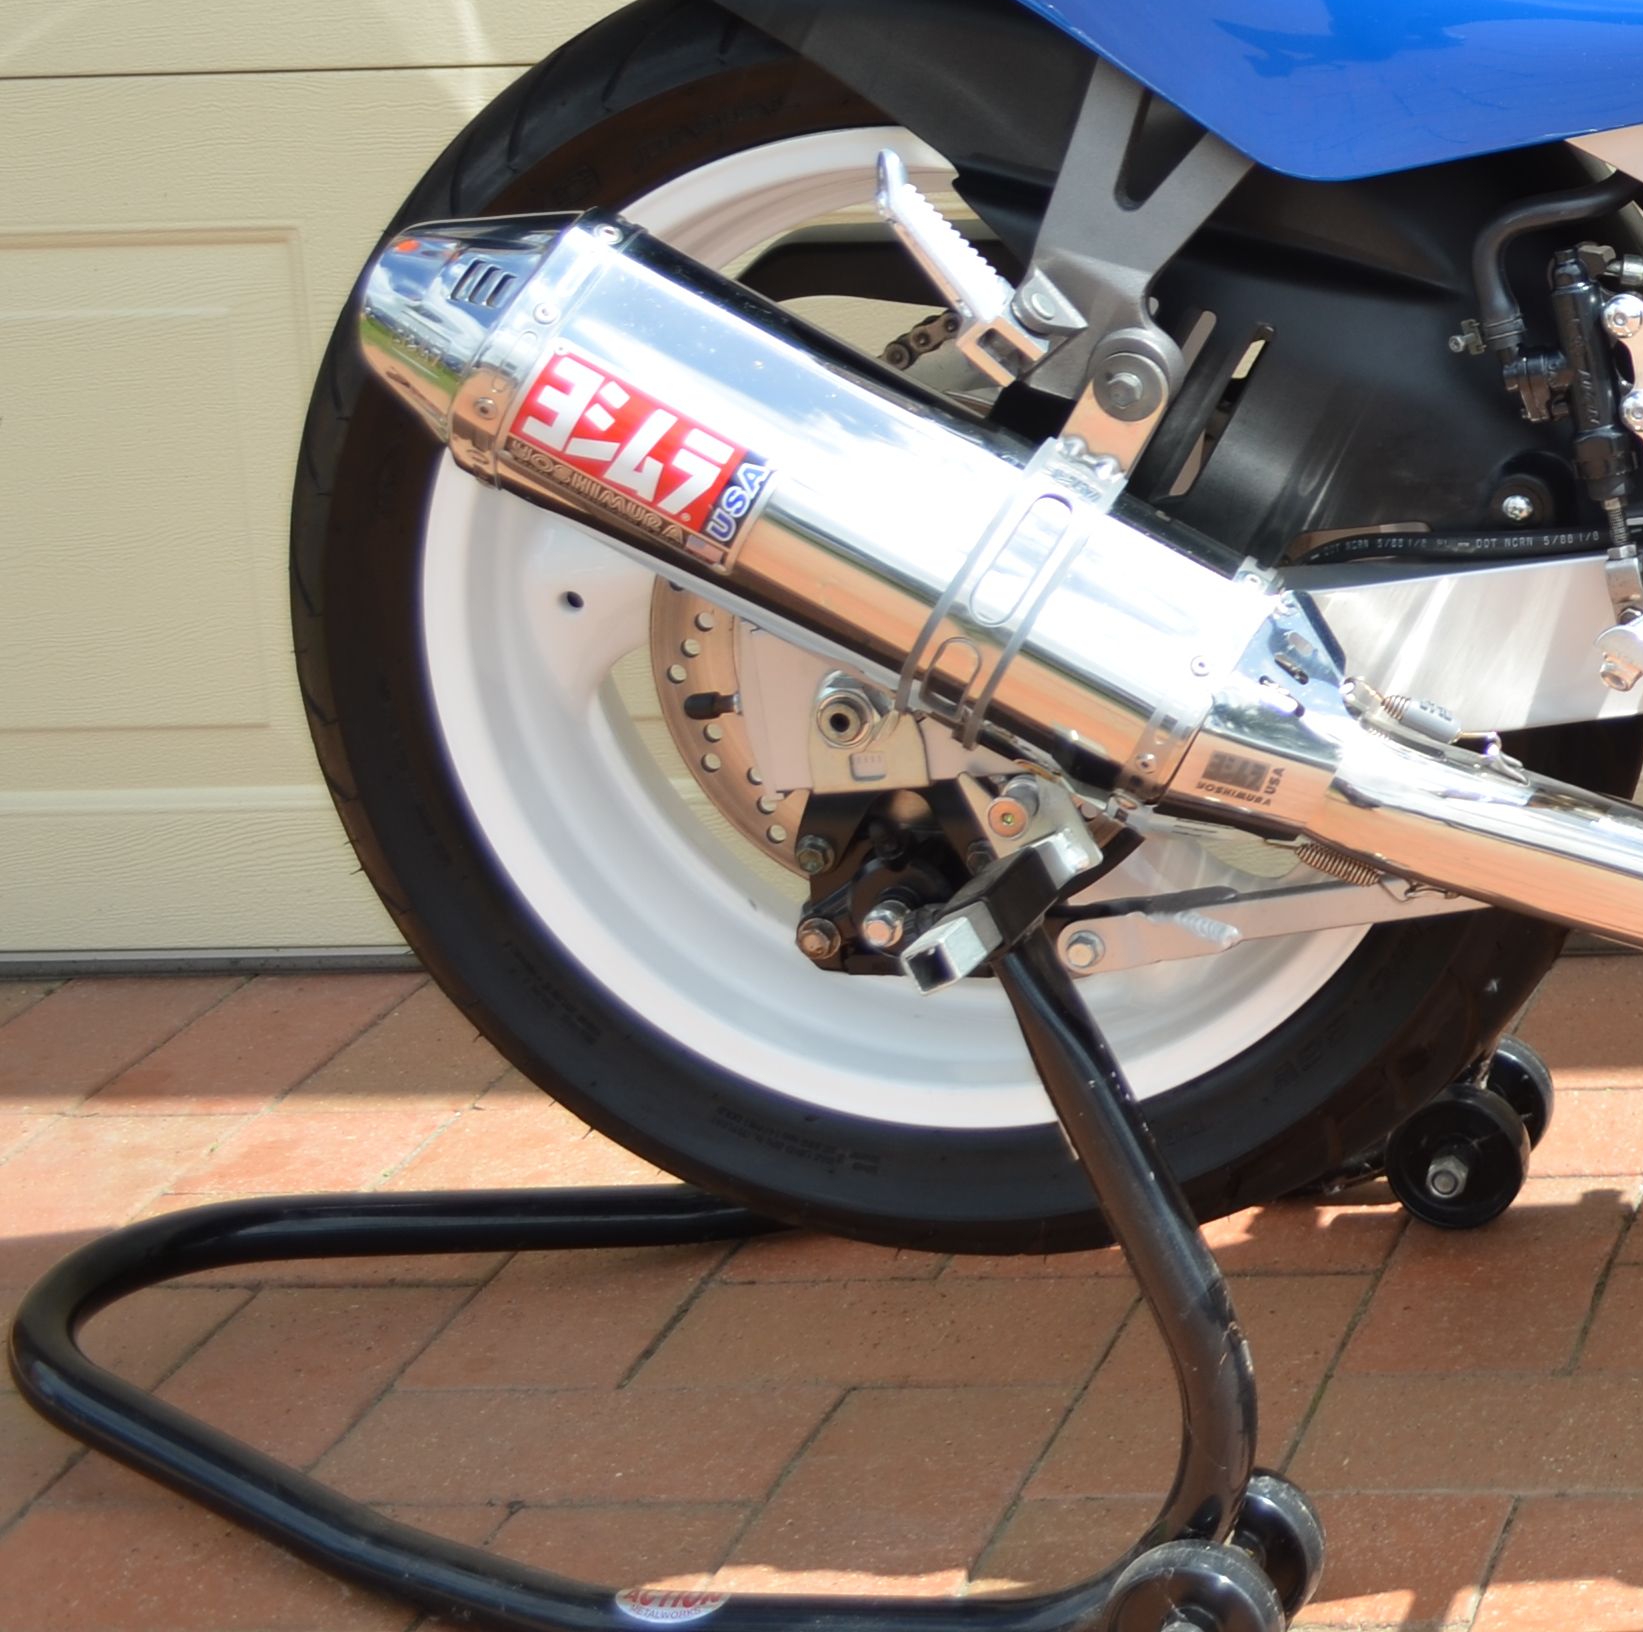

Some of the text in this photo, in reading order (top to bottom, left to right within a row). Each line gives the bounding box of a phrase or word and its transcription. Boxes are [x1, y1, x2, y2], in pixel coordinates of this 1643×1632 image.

[521, 356, 736, 516] ヨシムラ
[510, 438, 686, 544] YOSHIMURA
[705, 461, 772, 543] USA
[1196, 781, 1272, 806] YOSHIMURA
[1263, 768, 1285, 795] USA
